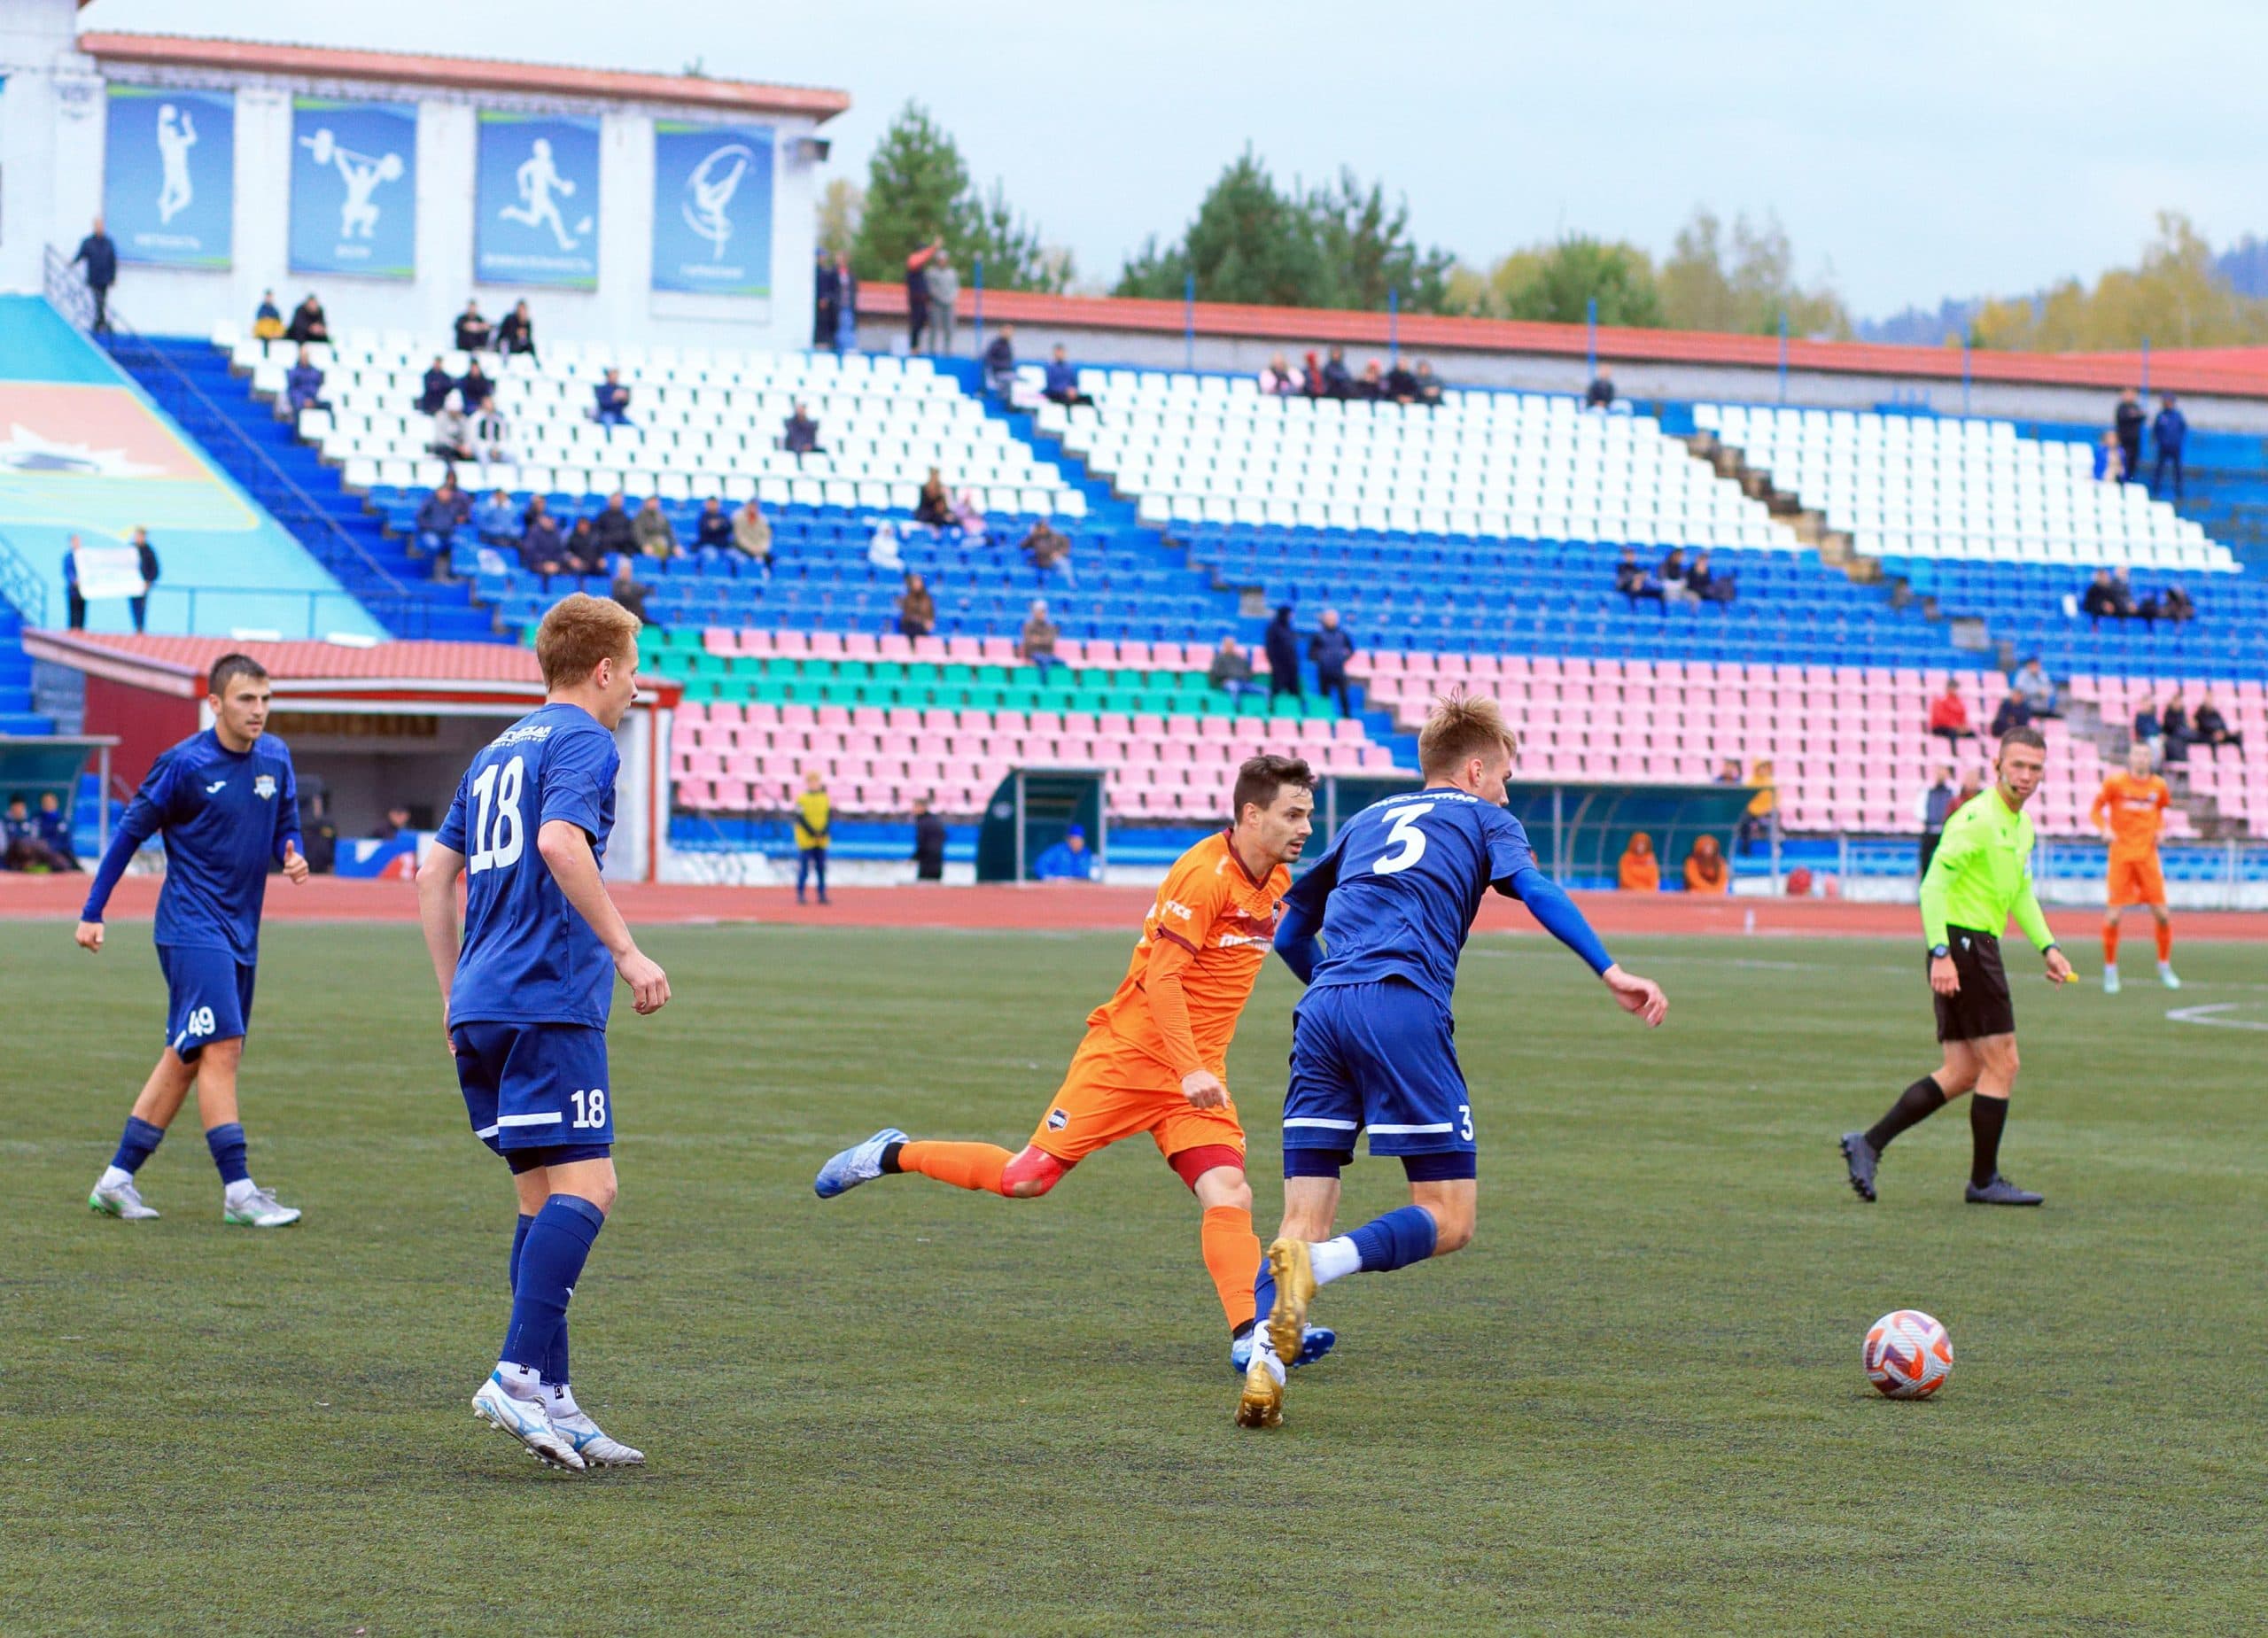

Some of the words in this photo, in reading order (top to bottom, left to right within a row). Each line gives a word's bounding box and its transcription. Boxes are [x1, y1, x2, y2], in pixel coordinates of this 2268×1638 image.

[470, 756, 524, 874] 18
[1372, 803, 1435, 874] 3
[188, 1006, 216, 1036] 49
[571, 1089, 606, 1129] 18
[1458, 1105, 1473, 1141] 3
